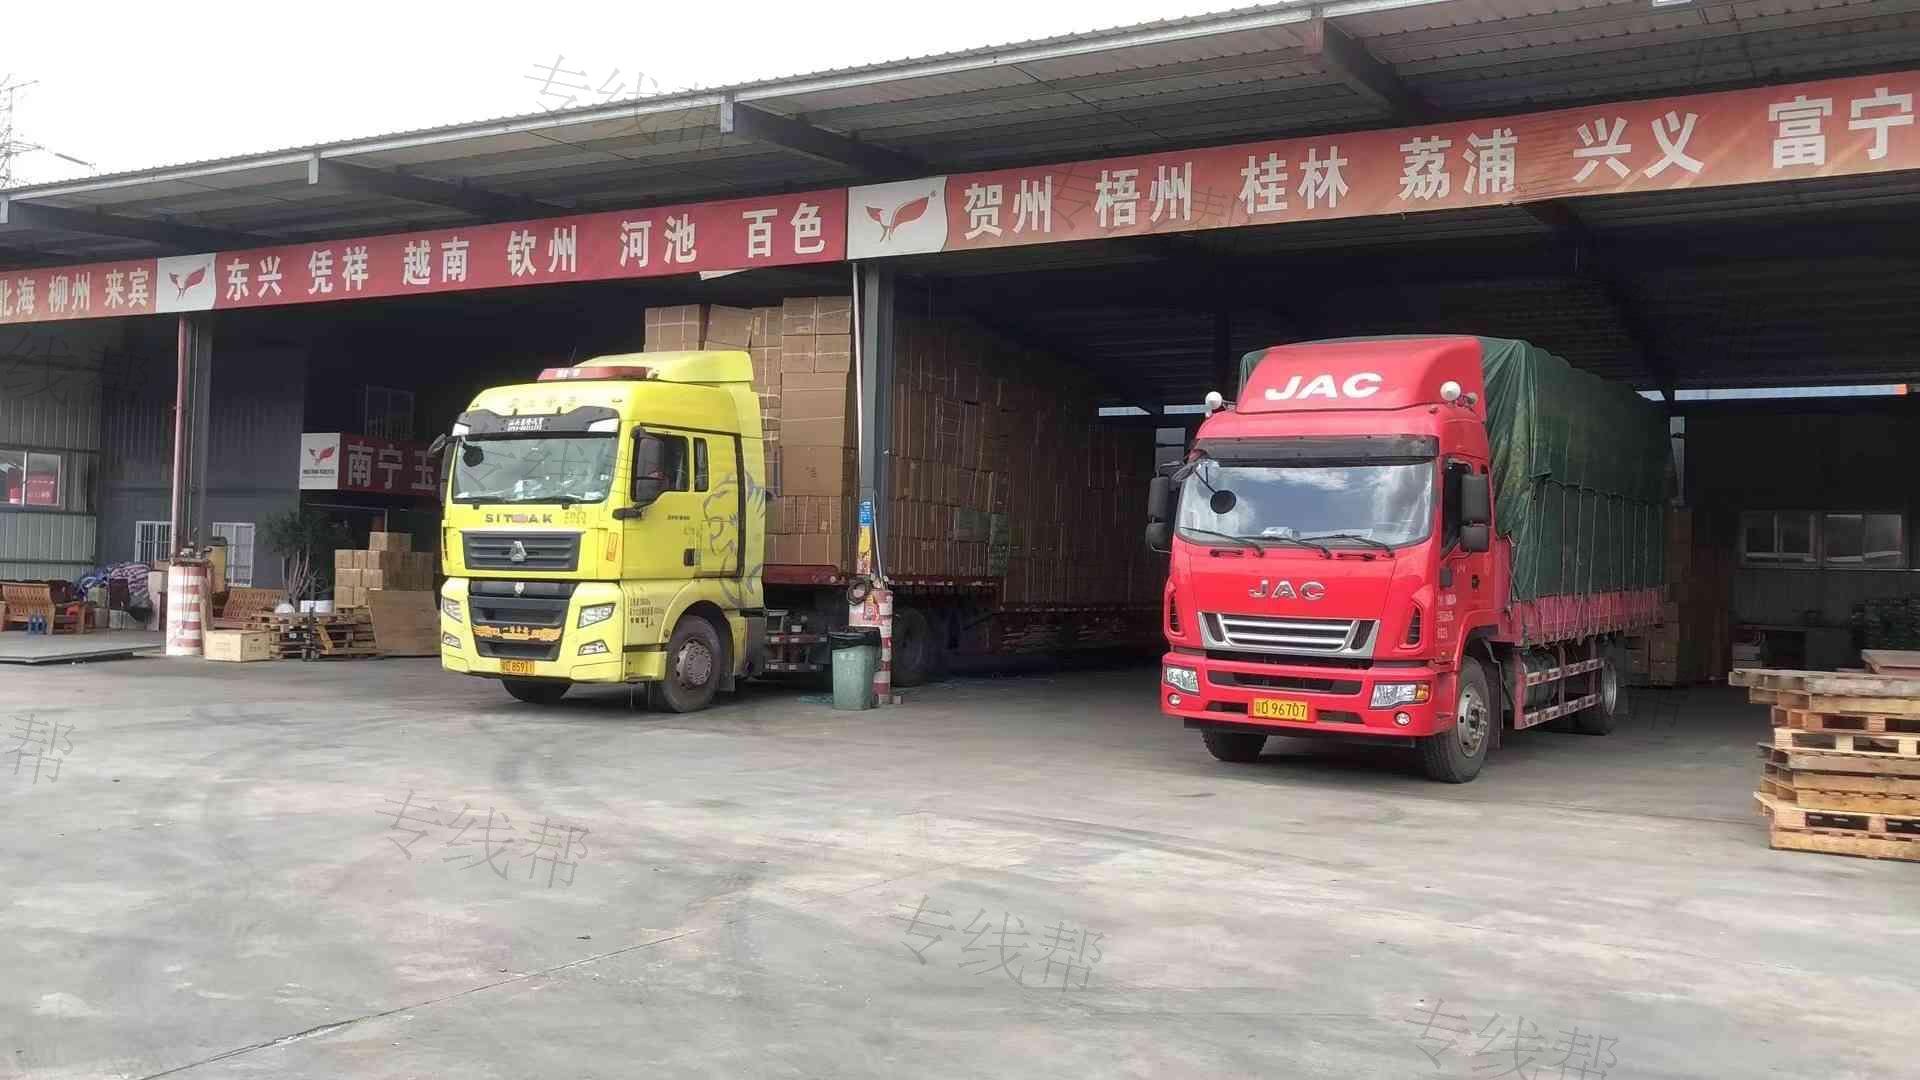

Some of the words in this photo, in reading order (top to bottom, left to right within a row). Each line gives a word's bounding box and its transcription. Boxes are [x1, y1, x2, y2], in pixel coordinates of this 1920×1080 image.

[963, 175, 1053, 240] 贺州
[1094, 161, 1193, 228] 梧州
[1239, 145, 1350, 215] 桂林
[1398, 128, 1518, 200] 荔浦
[1572, 110, 1704, 184] 兴义
[1767, 87, 1916, 168] 富宁
[226, 255, 282, 303] 东兴
[306, 245, 369, 295] 凭祥
[402, 236, 470, 287] 越南
[506, 225, 578, 278] 钦州
[618, 213, 698, 267] 河池
[742, 202, 825, 259] 百色
[48, 271, 91, 313] 柳州
[104, 267, 150, 309] 来宾
[1264, 372, 1384, 401] JAC
[485, 513, 553, 524] SITAK
[1247, 580, 1328, 600] JAC
